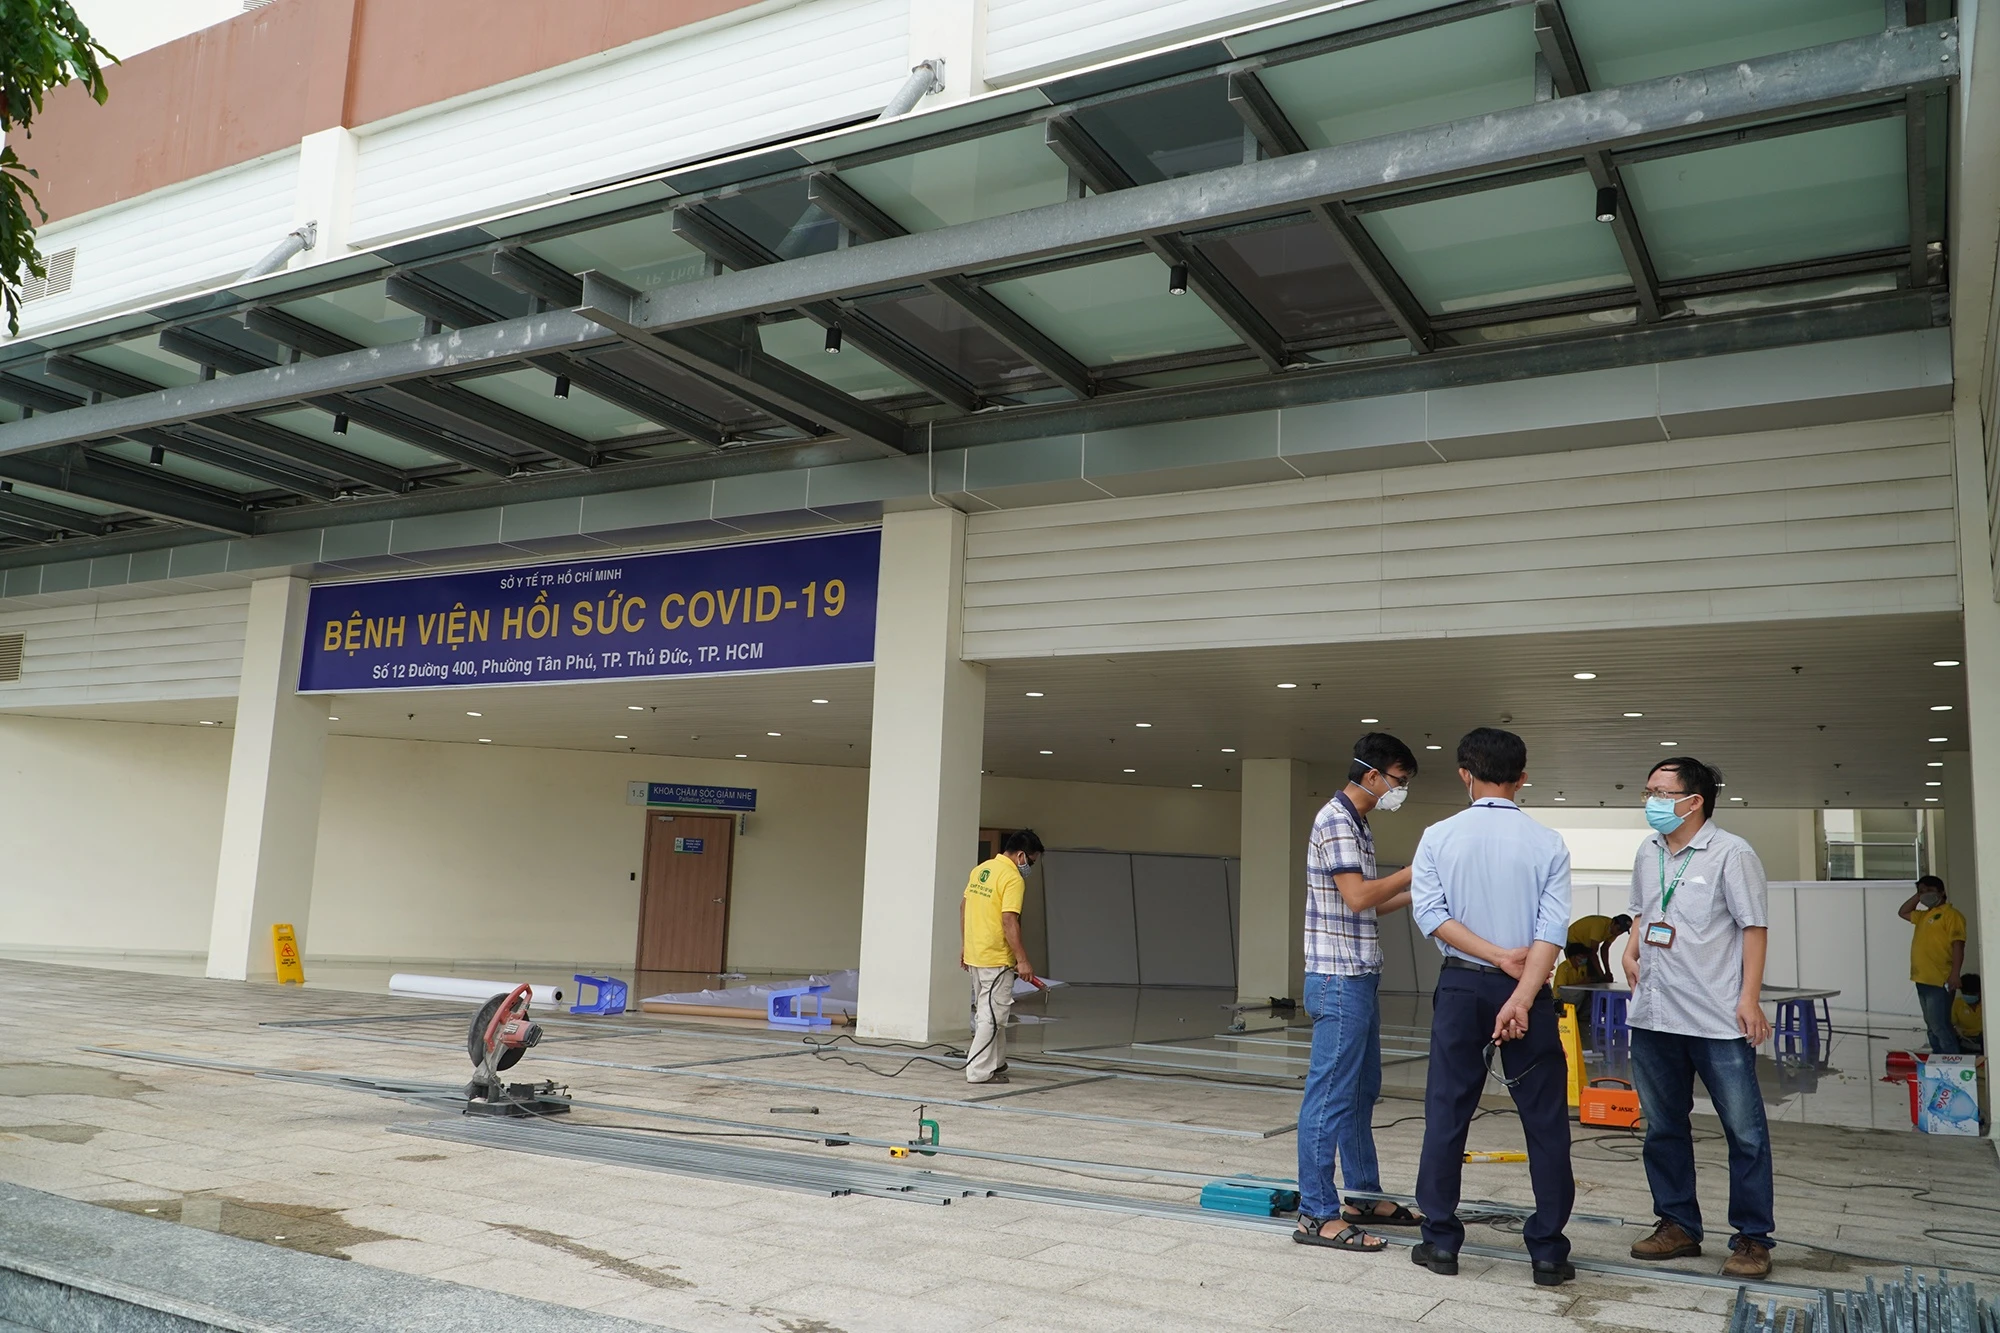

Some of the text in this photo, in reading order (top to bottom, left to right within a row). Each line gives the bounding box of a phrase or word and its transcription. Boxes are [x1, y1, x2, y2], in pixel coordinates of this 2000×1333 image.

[500, 568, 622, 589] SỞ Y TẾ TP. HỒ CHÍ MINH
[323, 578, 846, 657] BỆNH VIỆN HỒI SỨC COVID-19
[372, 642, 764, 680] Số 12 Đường 400, Phường Tân Phú, TP. Thủ Đức, TP. HCM
[632, 789, 645, 798] 1.5
[675, 787, 698, 797] CHĂM
[699, 788, 715, 798] SÓC
[716, 788, 735, 799] GIẢM
